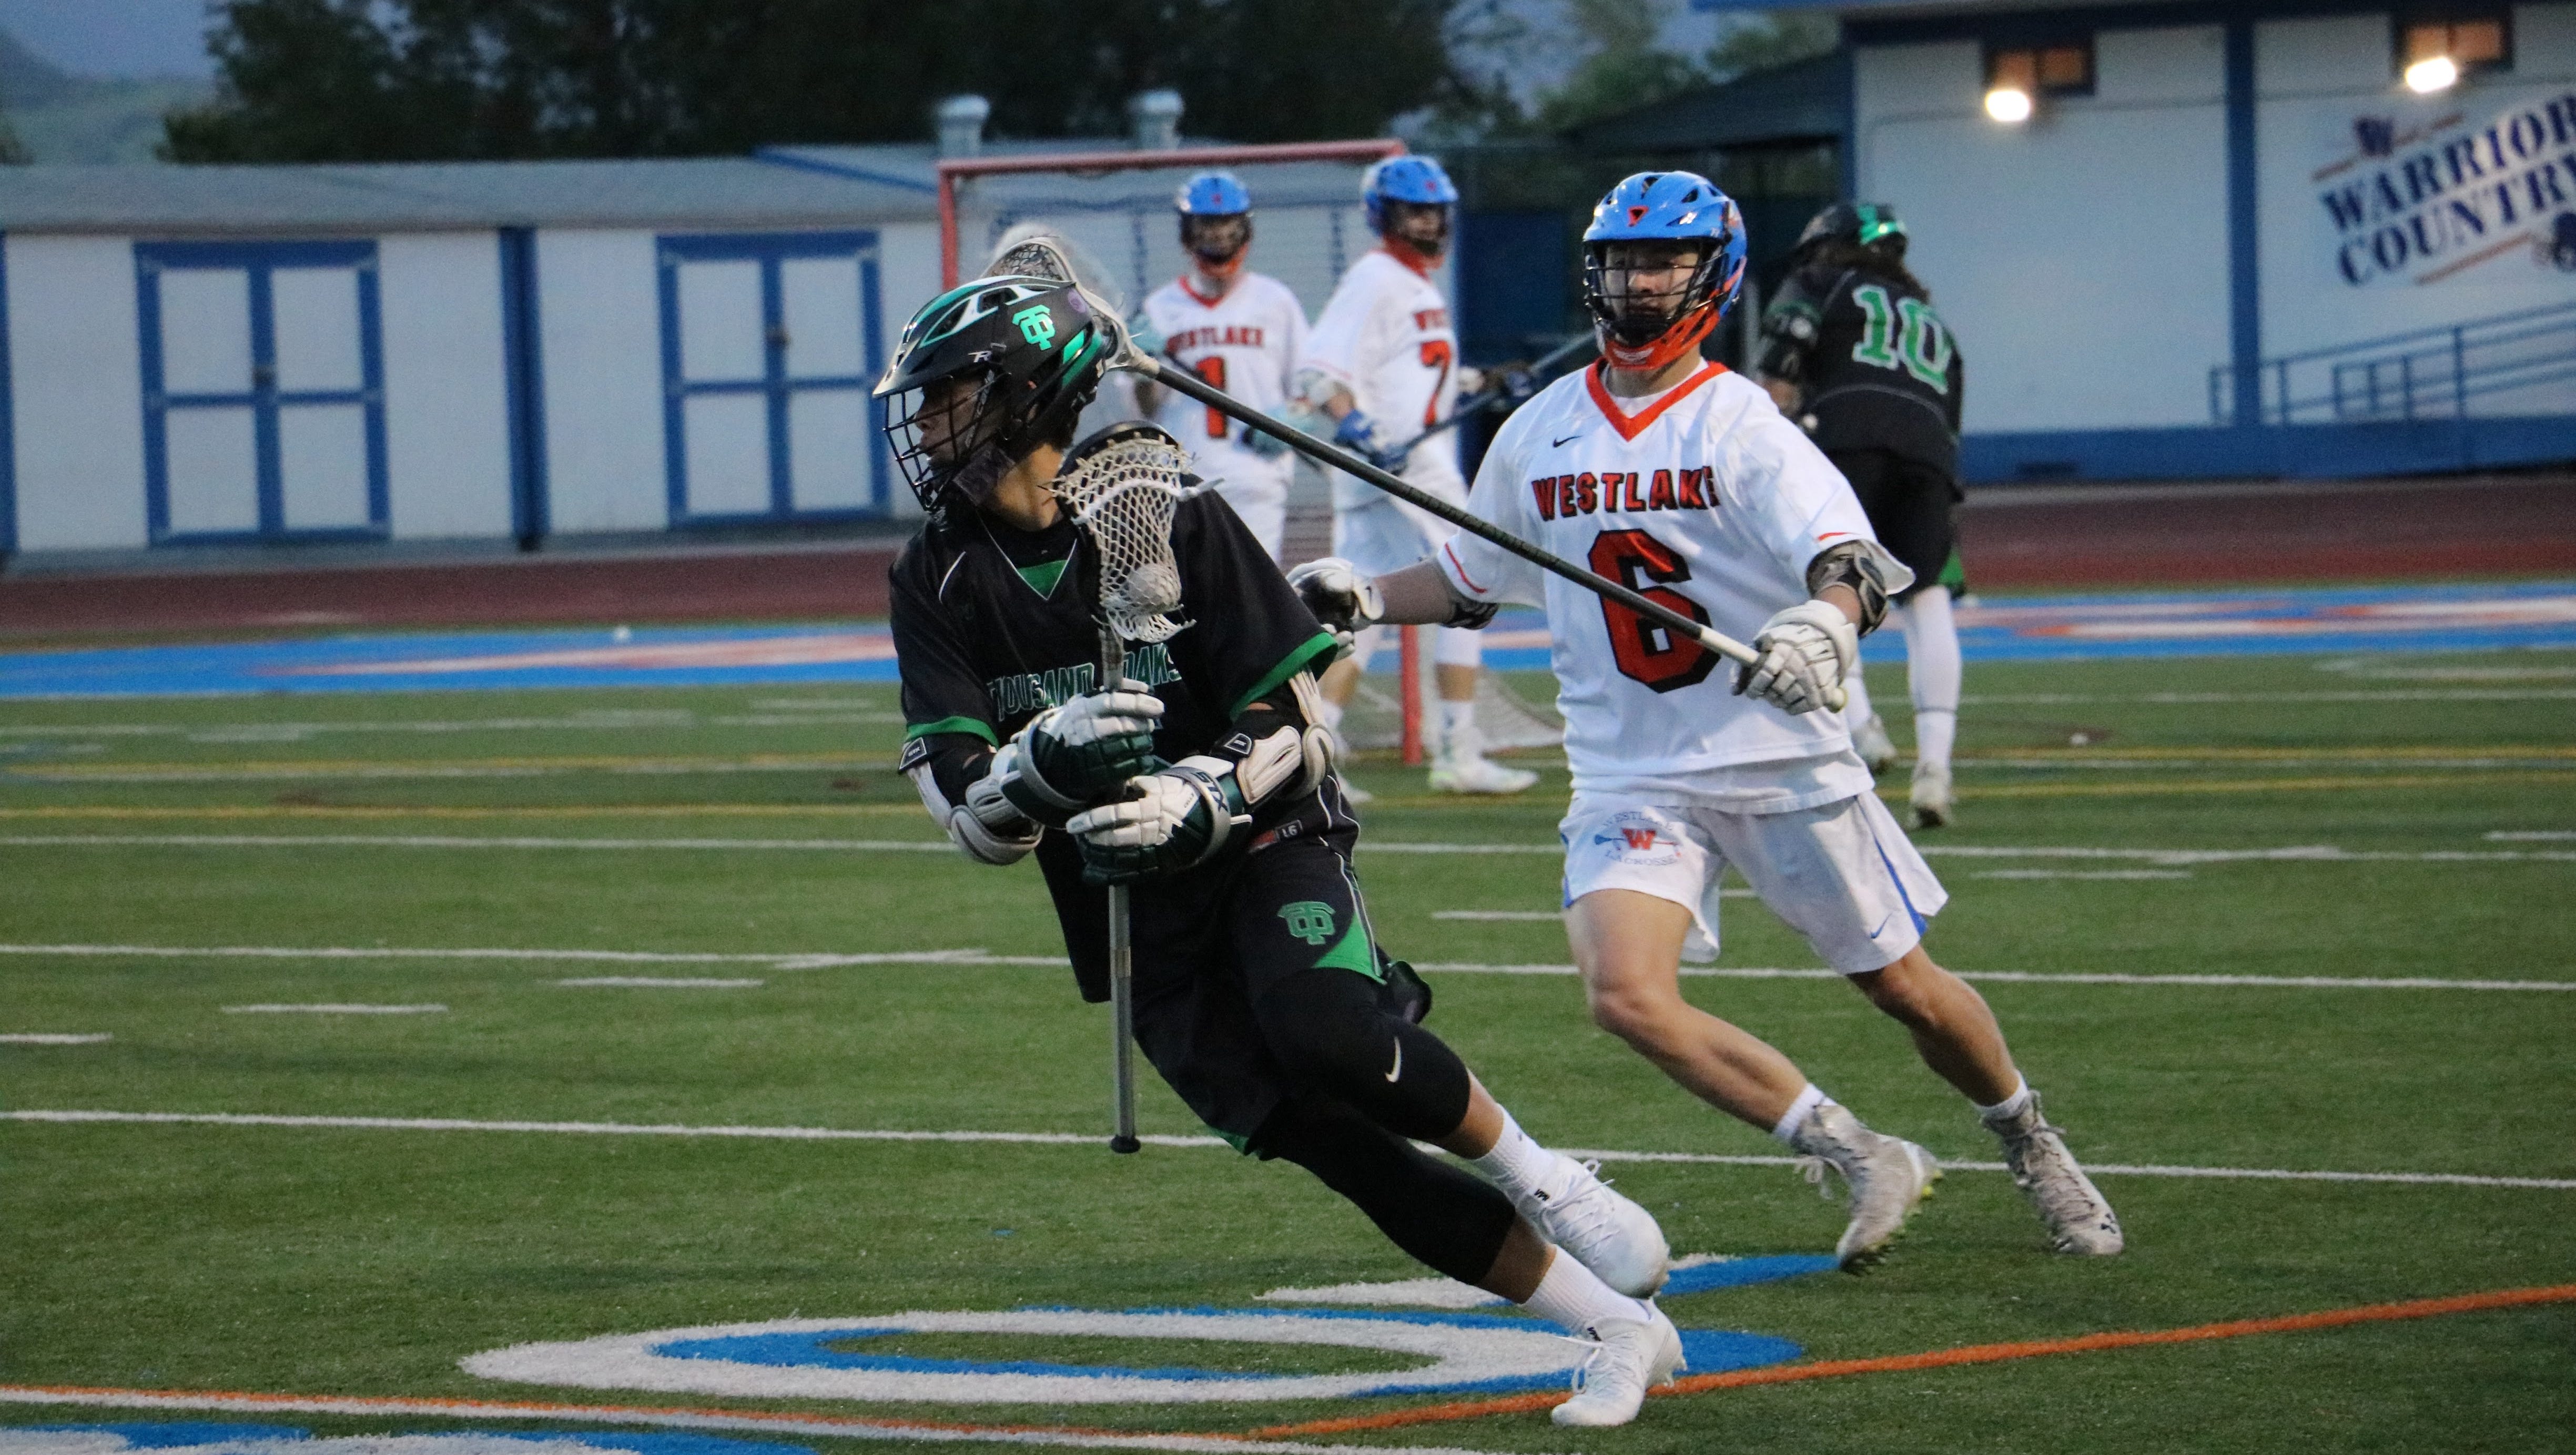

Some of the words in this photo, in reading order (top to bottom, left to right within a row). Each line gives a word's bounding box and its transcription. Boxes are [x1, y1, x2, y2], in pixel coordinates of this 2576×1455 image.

[1852, 284, 1952, 395] 10
[1196, 355, 1228, 439] 1
[1419, 340, 1451, 427] 7
[1587, 527, 1722, 694] 6
[1190, 771, 1229, 812] STX
[1621, 828, 1657, 850] W
